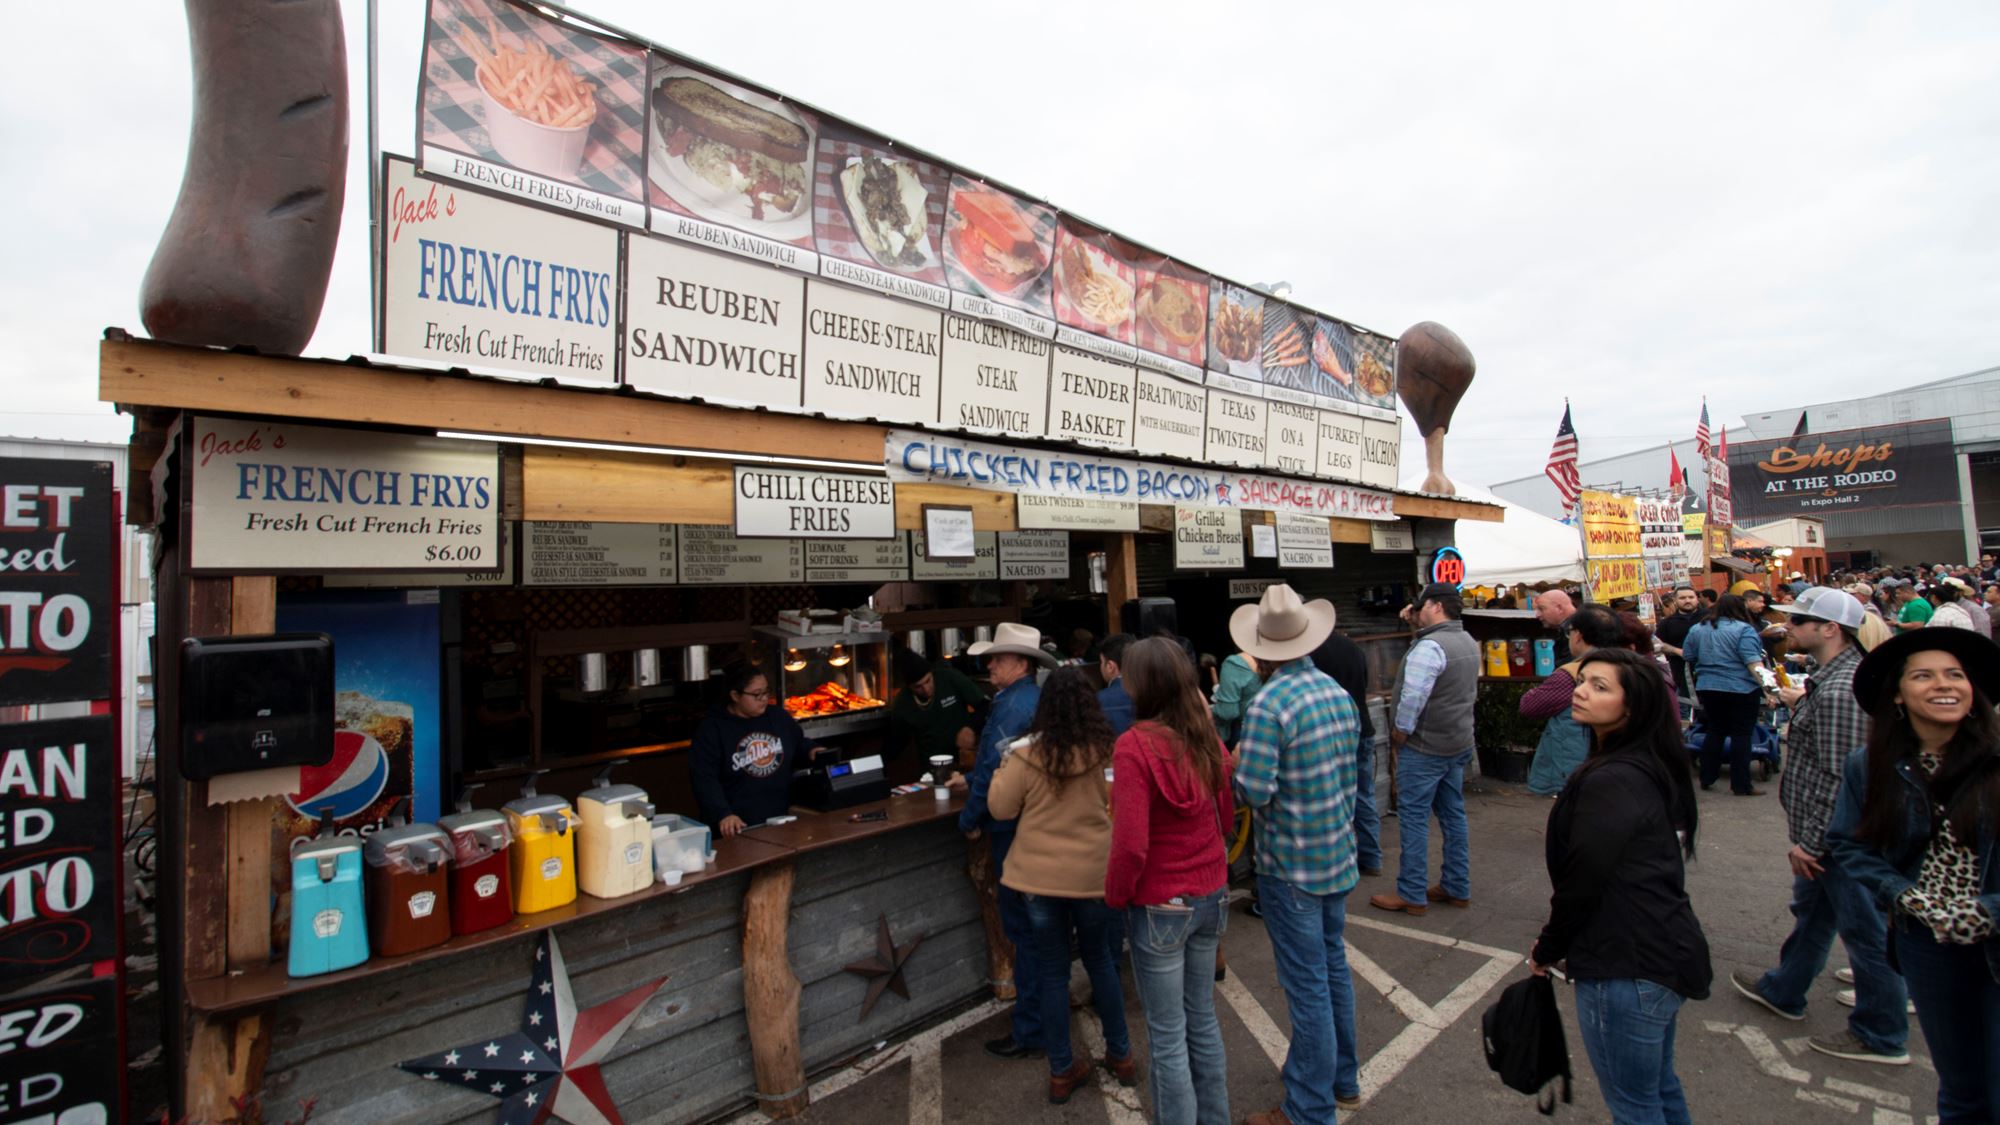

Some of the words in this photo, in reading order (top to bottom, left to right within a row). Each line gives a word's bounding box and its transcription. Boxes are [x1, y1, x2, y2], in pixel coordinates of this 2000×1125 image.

[453, 158, 526, 193] FRENCH
[529, 172, 573, 205] FRIES
[574, 187, 603, 212] fresh
[605, 200, 622, 217] cut
[392, 184, 456, 242] Jack's
[678, 219, 730, 247] REUBEN
[731, 232, 796, 264] SANDWICH
[418, 239, 543, 317] FRENCH
[549, 264, 610, 328] FRYS
[826, 260, 895, 291] CHEESESTEAK
[897, 276, 945, 305] SANDWICH
[656, 276, 780, 327] REUBEN
[424, 322, 471, 354] Fresh
[476, 328, 508, 359] Cut
[511, 333, 564, 366] French
[567, 341, 603, 371] Fries
[810, 309, 880, 346] CHEESE
[885, 324, 937, 357] STEAK
[947, 315, 1007, 349] CHICKEN
[1011, 333, 1047, 357] FRIED
[631, 328, 798, 379] SANDWICH
[825, 360, 920, 397] SANDWICH
[977, 364, 1017, 392] STEAK
[1062, 372, 1129, 404] TENDER
[1139, 381, 1203, 413] BRATWURST
[1221, 398, 1256, 421] TEXAS
[960, 403, 1029, 433] SANDWICH
[1061, 410, 1125, 438] BASKET
[1272, 401, 1315, 422] SAUSAGE
[1140, 415, 1158, 429] WITH
[1159, 418, 1200, 437] SAUERKRAUT
[1209, 427, 1264, 453] TWISTERS
[1281, 428, 1295, 444] ON
[1297, 433, 1304, 446] A
[1321, 424, 1360, 446] TURKEY
[201, 427, 286, 467] Jack's
[1328, 452, 1352, 469] LEGS
[1363, 437, 1397, 467] NACHOS
[1758, 442, 1895, 474] Shops
[902, 442, 1040, 488] CHICKEN
[1049, 460, 1130, 496] FRIED
[1137, 467, 1210, 500] BACON
[1277, 455, 1305, 471] STICK
[236, 463, 401, 505] FRENCH
[410, 473, 490, 510] FRYS
[740, 472, 805, 501] CHILI
[811, 476, 891, 505] CHEESE
[1764, 480, 1787, 493] AT
[1792, 476, 1828, 490] THE
[1834, 469, 1897, 487] RODEO
[4, 484, 84, 527] ET
[1023, 495, 1047, 506] TEXAS
[1048, 496, 1084, 508] TWISTERS
[1239, 478, 1313, 508] SAUSAGE
[1317, 487, 1336, 510] ON
[1340, 489, 1348, 510] A
[1352, 491, 1387, 514] STICK
[1801, 499, 1810, 507] in
[1811, 498, 1833, 507] Expo
[1834, 496, 1852, 504] Hall
[245, 512, 309, 533] Fresh
[317, 514, 356, 533] Cut
[363, 516, 430, 534] French
[437, 518, 482, 536] Fries
[789, 506, 850, 532] FRIES
[1195, 510, 1225, 526] Grilled
[809, 543, 847, 553] LEMONADE
[1178, 527, 1215, 543] Chicken
[1216, 528, 1242, 544] Breast
[425, 544, 481, 562] $6.00
[809, 556, 828, 565] SOFT
[830, 556, 858, 565] DRINKS
[975, 546, 994, 557] east
[1283, 552, 1313, 563] NACHOS
[1006, 565, 1046, 576] NACHOS
[1435, 560, 1465, 584] OPEN
[1233, 582, 1258, 594] BOB'S
